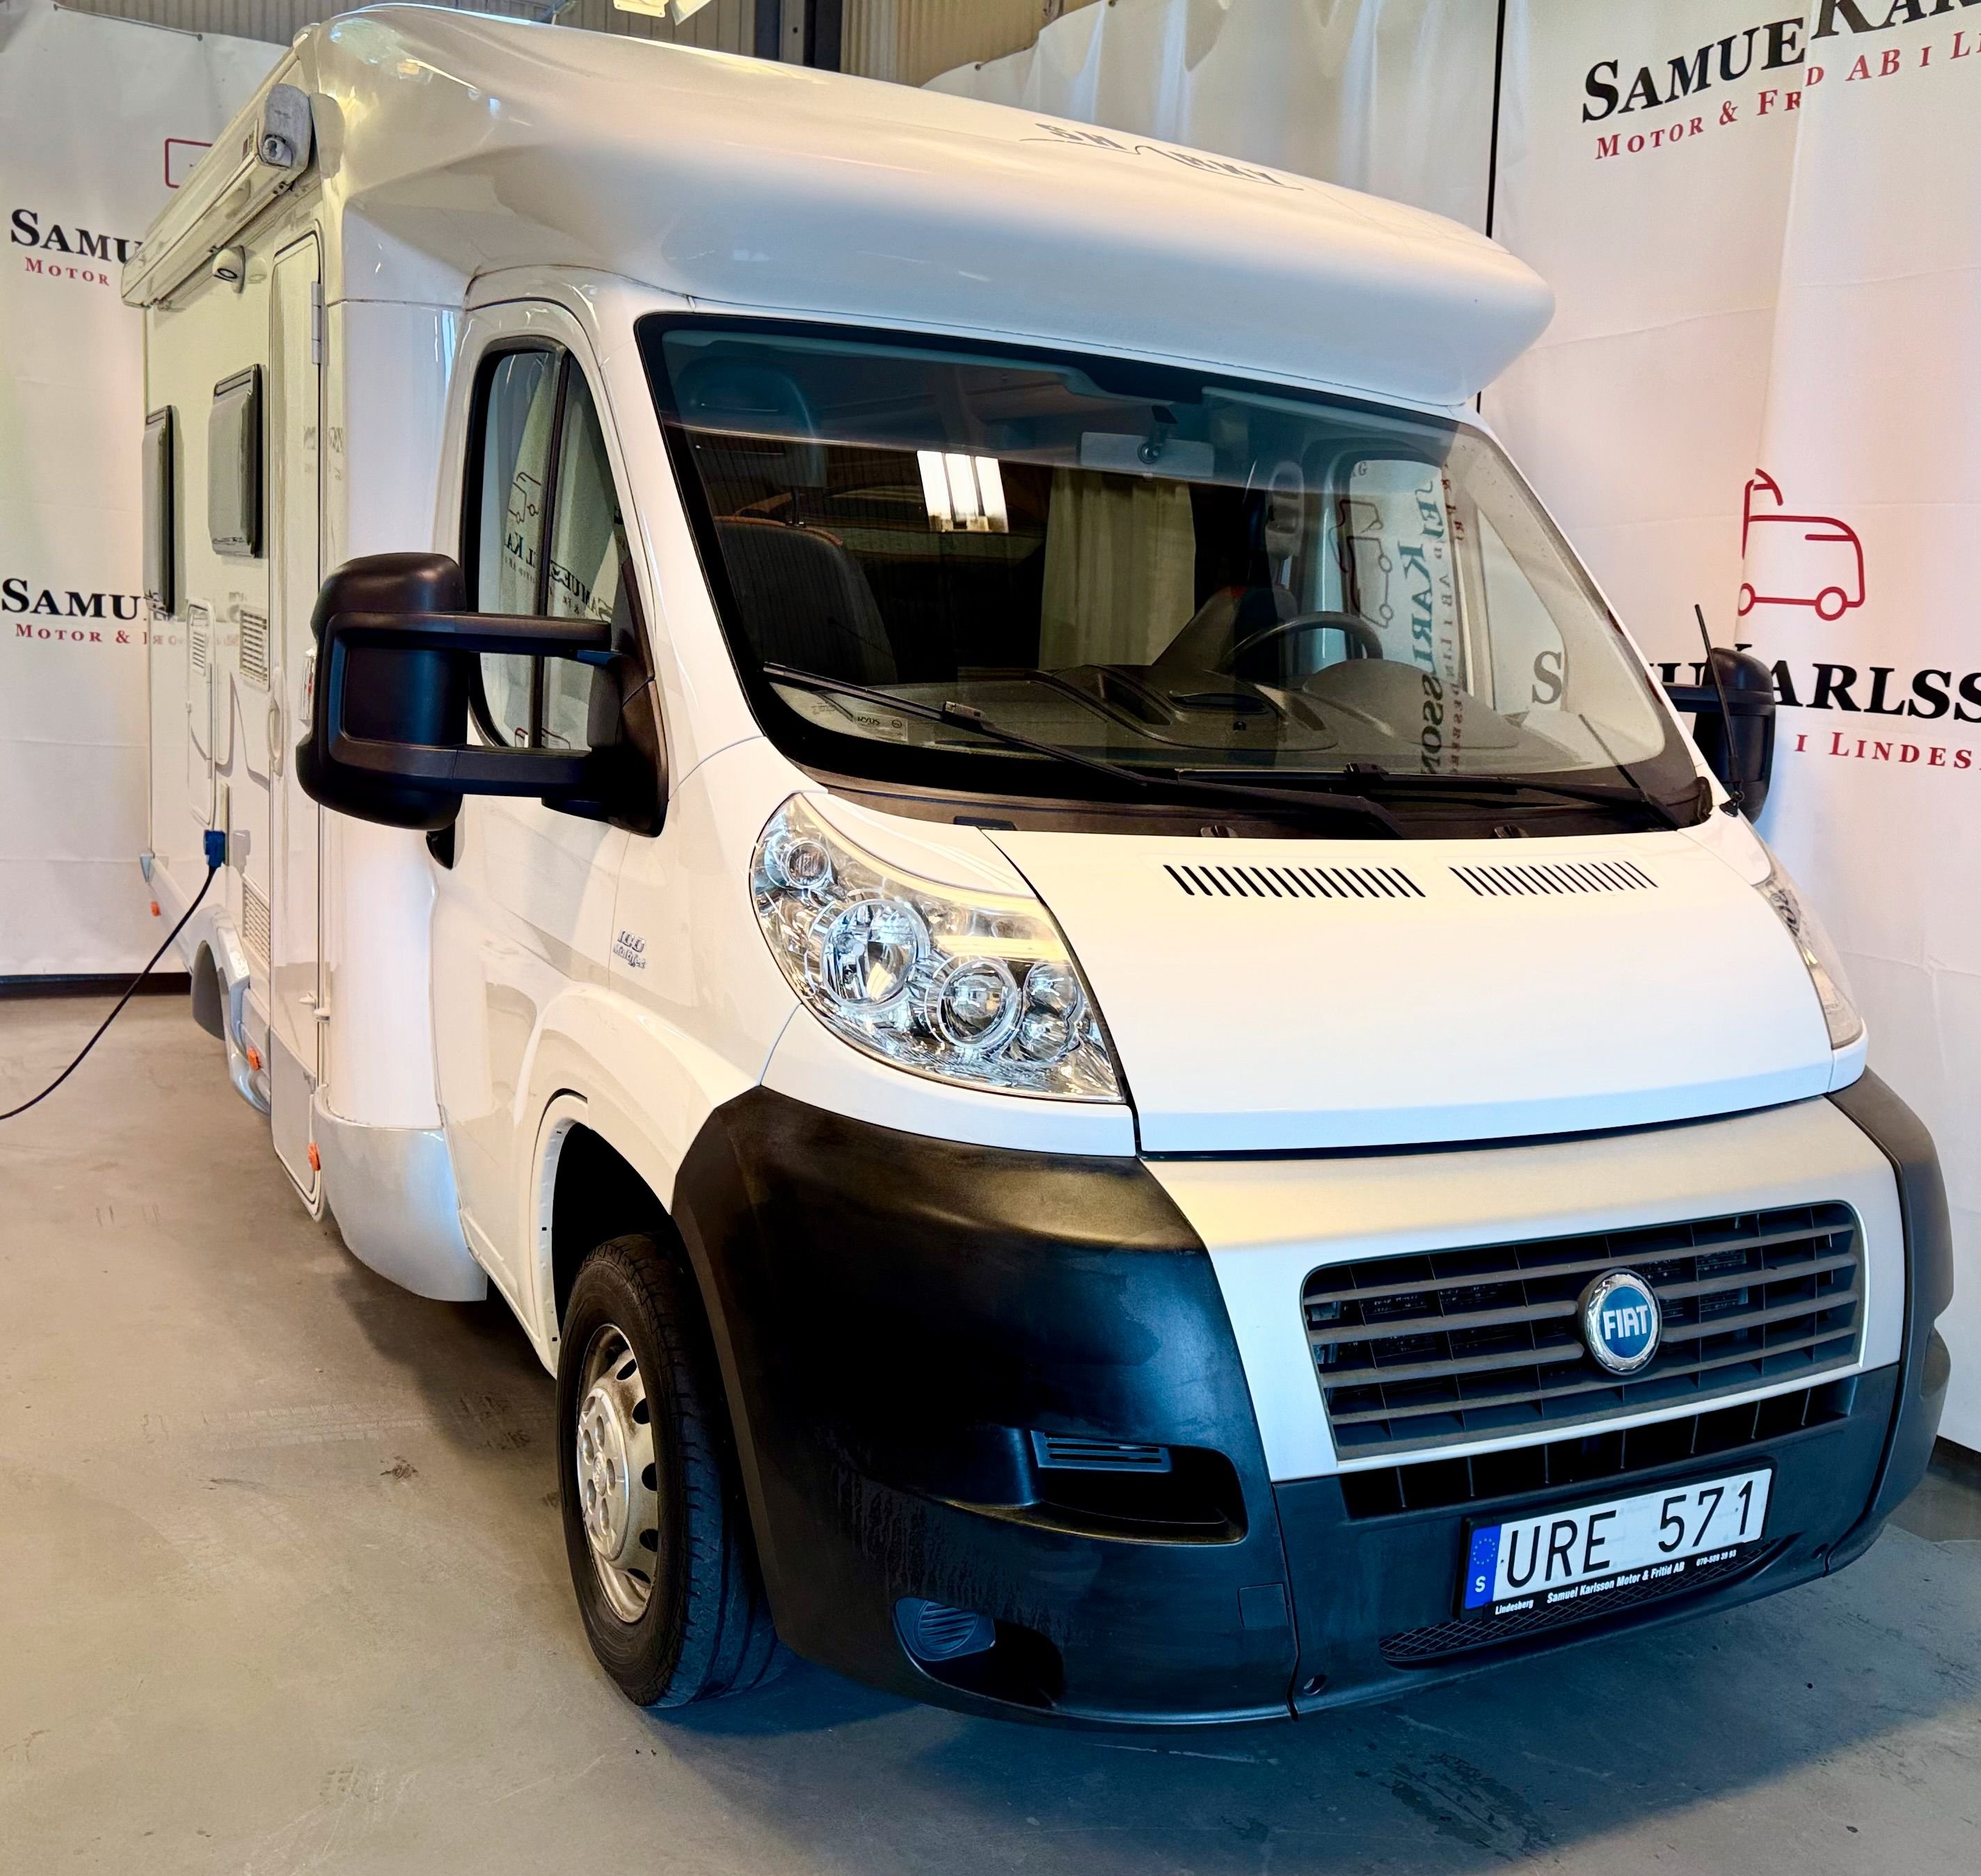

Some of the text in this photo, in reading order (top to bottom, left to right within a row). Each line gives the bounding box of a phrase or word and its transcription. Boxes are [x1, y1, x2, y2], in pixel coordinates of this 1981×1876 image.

[1582, 17, 1806, 123] SAMUE
[1595, 117, 1704, 159] MOTOR
[1719, 101, 1737, 126] &
[1845, 49, 1900, 81] AB
[10, 209, 145, 264] SAMU
[25, 257, 111, 287] MOTOR
[1, 578, 143, 621] SAMU
[15, 623, 102, 642] MOTOR
[116, 630, 131, 644] &
[1829, 732, 1981, 769] LINDES
[1602, 1305, 1649, 1340] FIAT
[1506, 1480, 1754, 1589] URE 571
[1474, 1575, 1486, 1593] S
[1495, 1599, 1534, 1615] Lindesberg
[1547, 1586, 1578, 1604] Samuel
[1579, 1579, 1615, 1596] Karlsson
[1616, 1571, 1641, 1587] Motor
[1641, 1569, 1649, 1581] &
[1650, 1563, 1672, 1579] Fritid
[1673, 1561, 1685, 1573] AB
